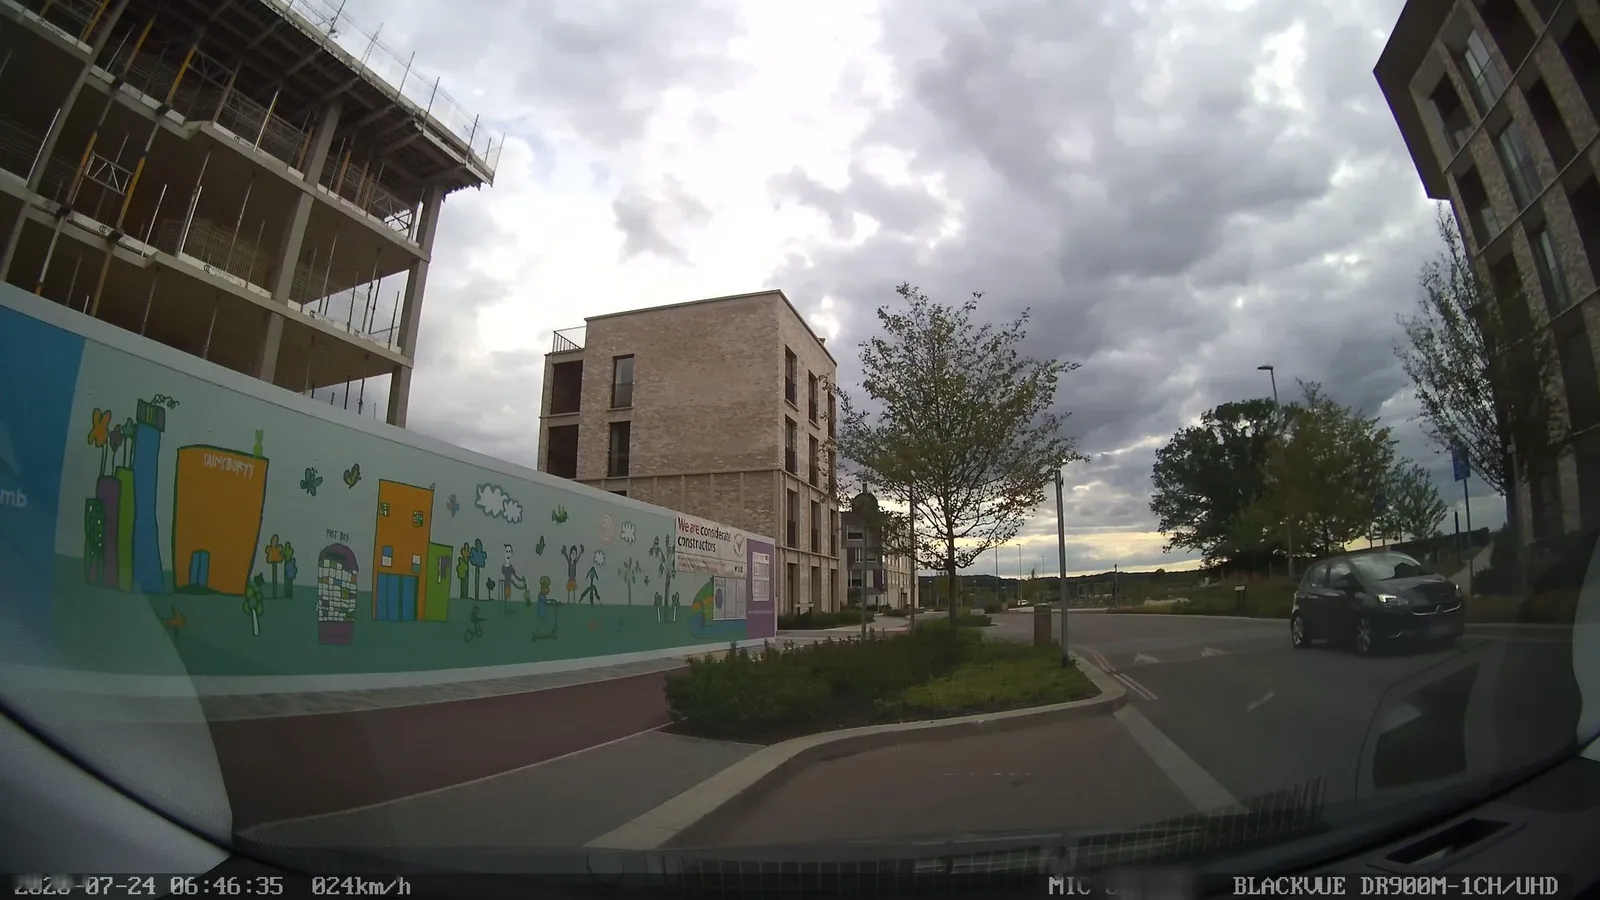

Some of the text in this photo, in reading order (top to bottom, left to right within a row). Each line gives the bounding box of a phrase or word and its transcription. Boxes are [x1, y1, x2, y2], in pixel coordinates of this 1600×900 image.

[677, 516, 731, 542] We are considerate
[677, 535, 716, 553] constructors
